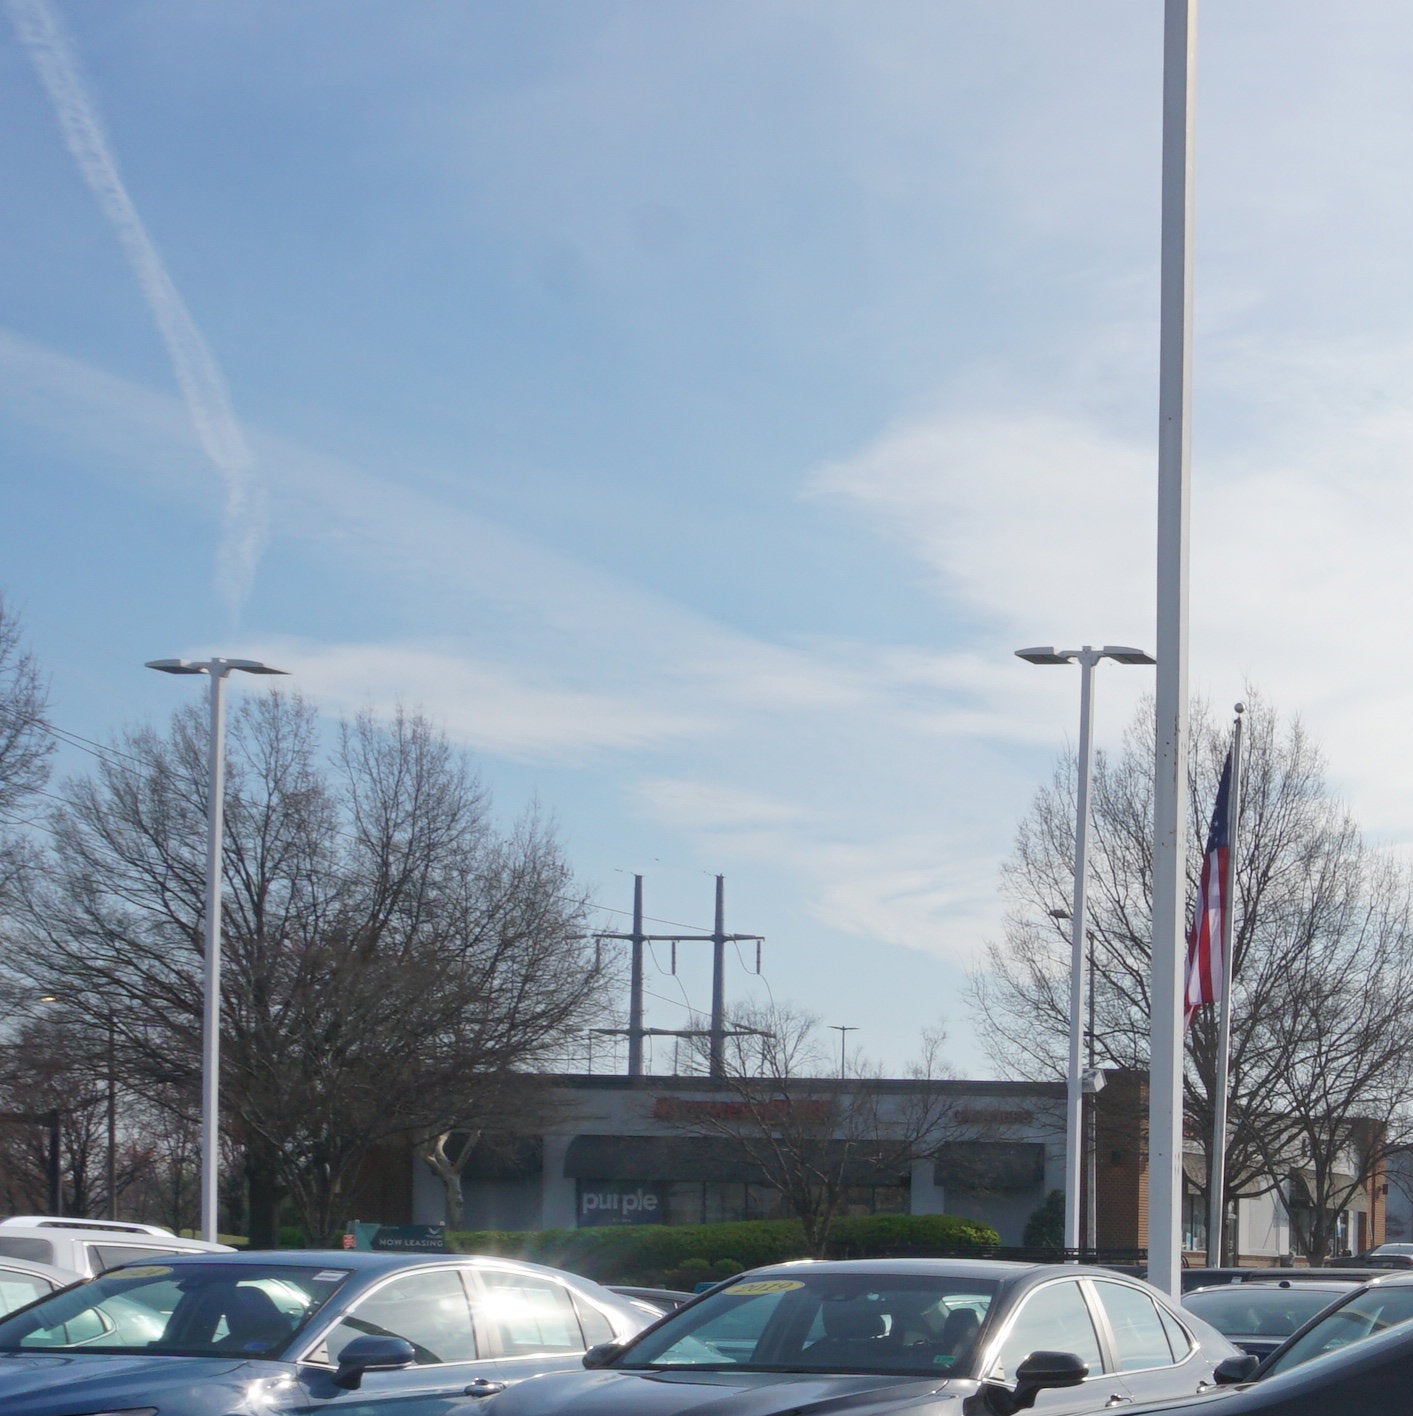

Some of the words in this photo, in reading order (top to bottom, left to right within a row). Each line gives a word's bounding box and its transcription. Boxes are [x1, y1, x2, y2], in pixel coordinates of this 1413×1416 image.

[582, 1188, 658, 1215] purple
[379, 1238, 402, 1247] NOW
[404, 1239, 444, 1248] LEASING
